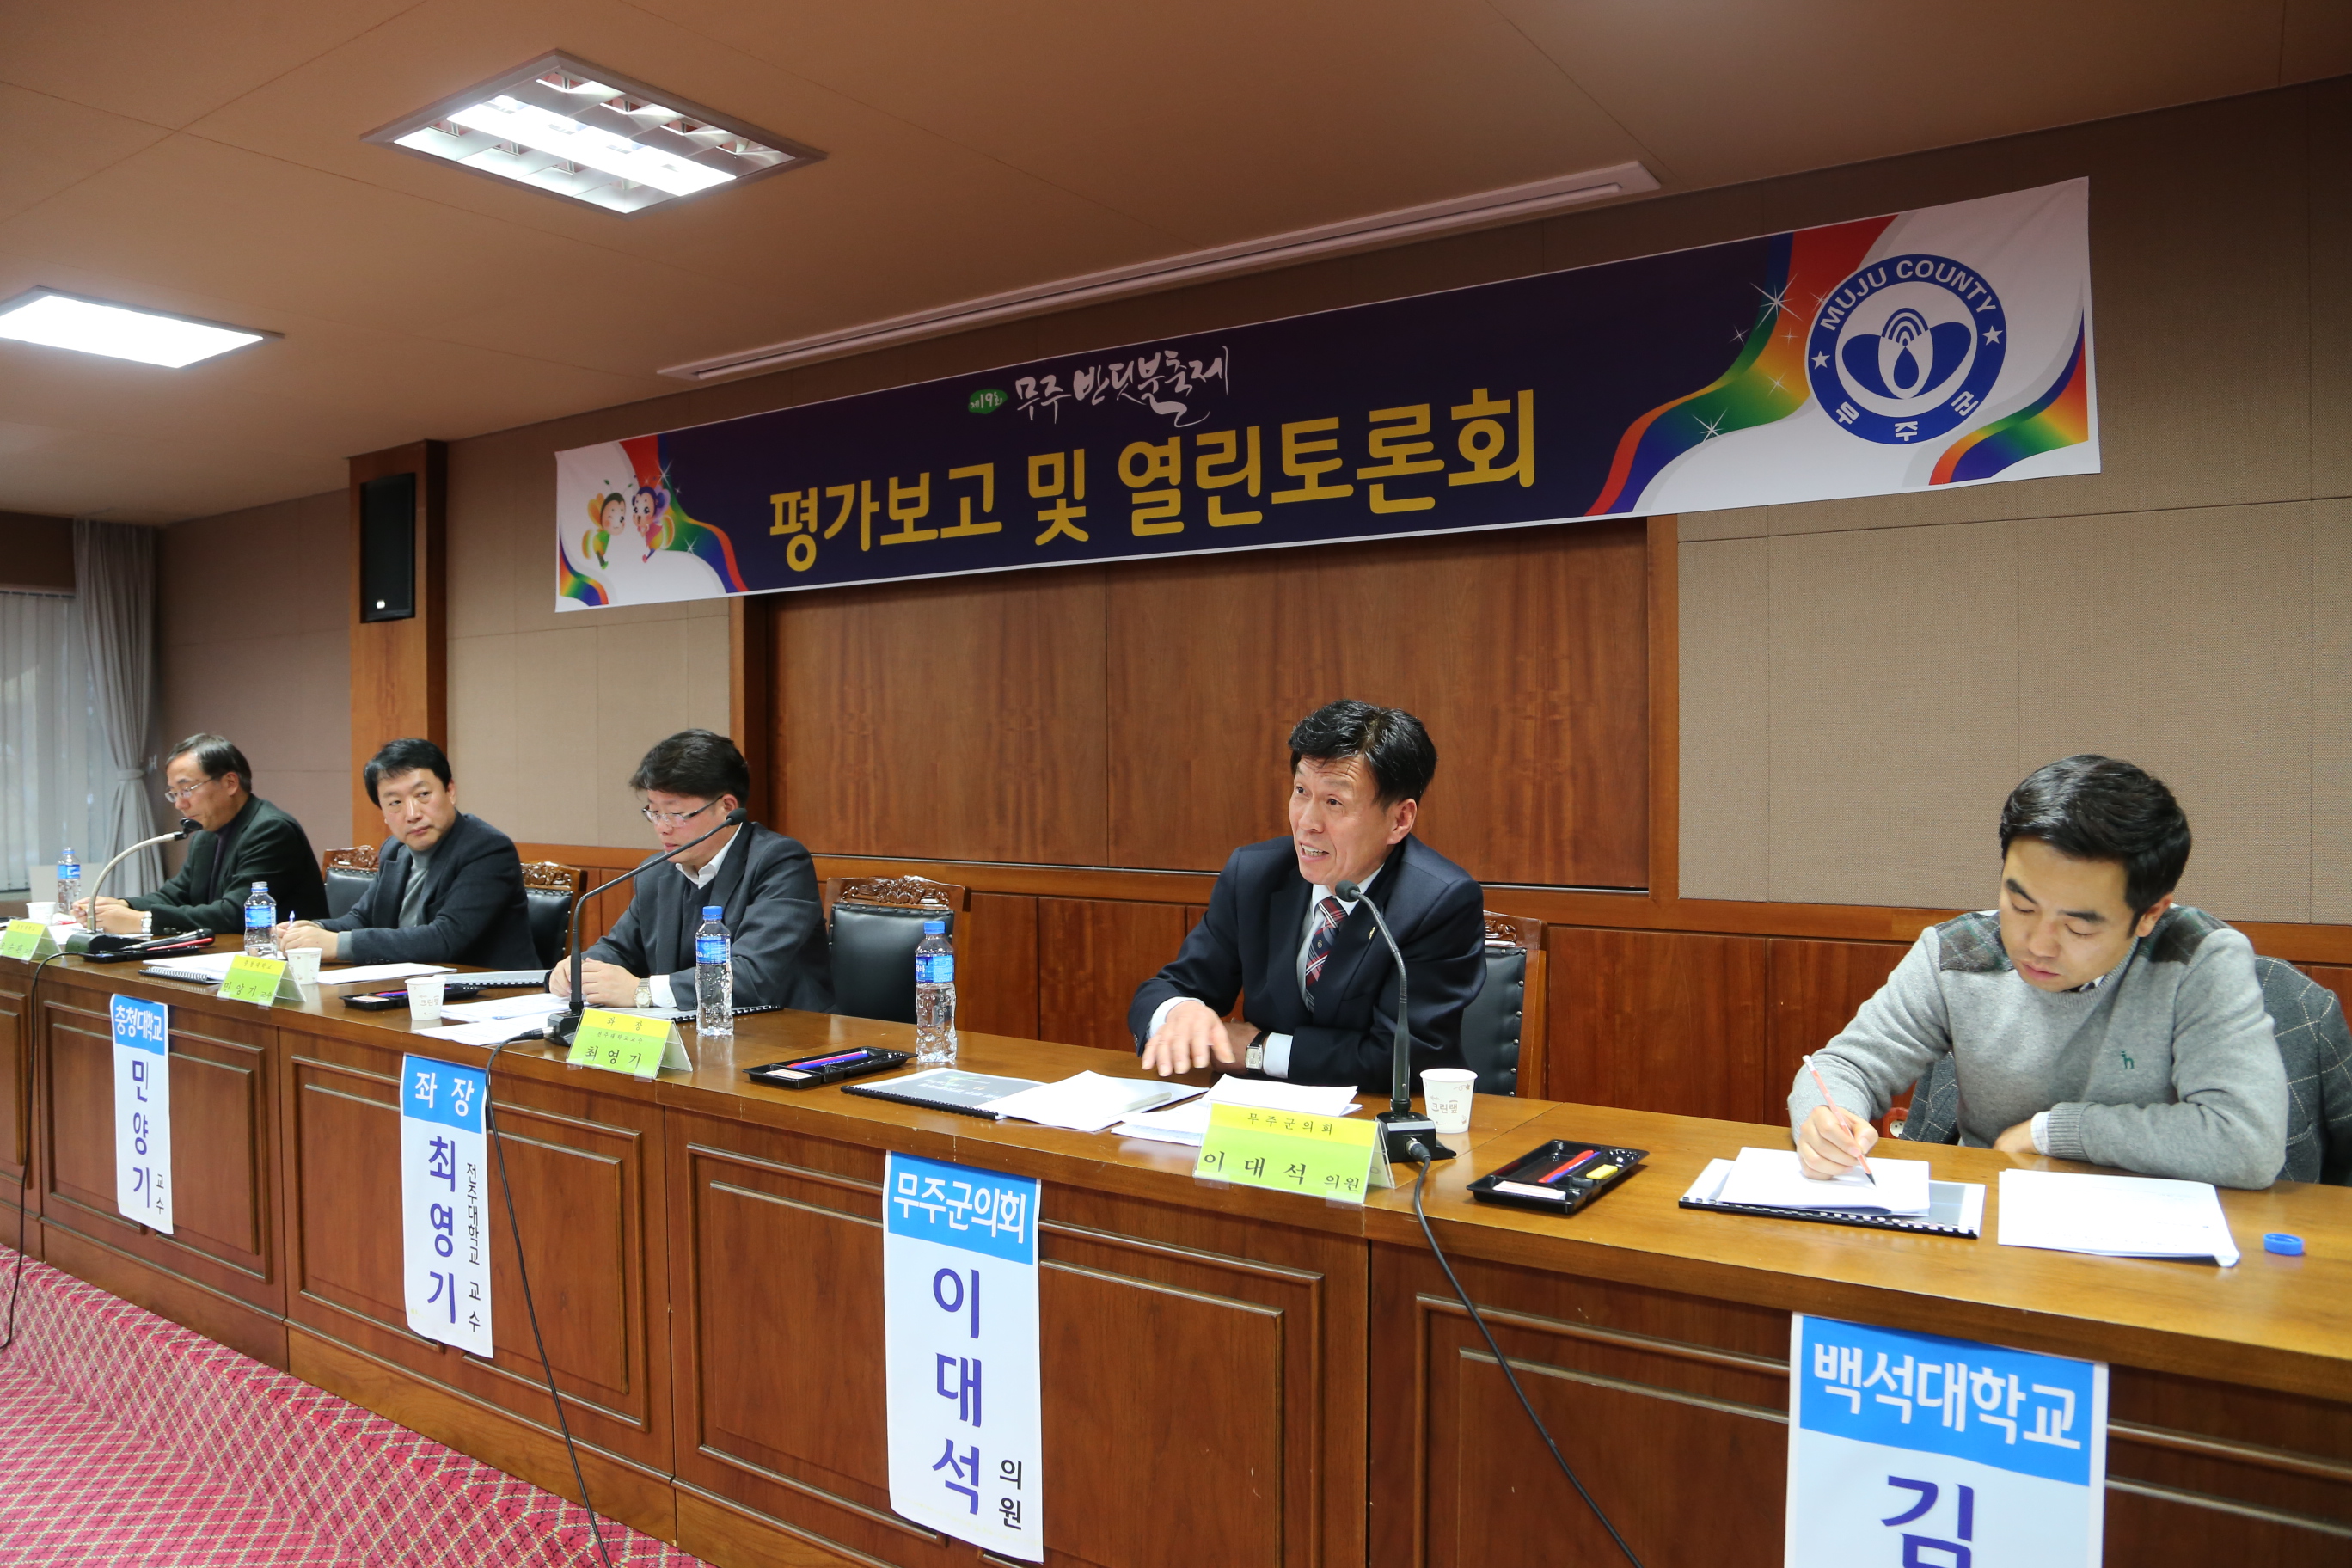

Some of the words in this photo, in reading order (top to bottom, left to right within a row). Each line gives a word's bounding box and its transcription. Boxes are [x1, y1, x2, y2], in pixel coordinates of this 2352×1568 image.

[1820, 267, 1887, 331] MUJU
[1896, 260, 1996, 313] COUNTY
[970, 391, 1003, 409] 제19회
[1015, 375, 1071, 424] 무주
[769, 462, 1002, 572] 평가보고
[1028, 449, 1089, 546] 및
[1118, 388, 1534, 537] 열린토론회
[115, 1005, 163, 1042] 충청대학교
[1247, 1112, 1333, 1136] 무주군의회
[893, 1172, 1026, 1244] 무주군의회
[1324, 1174, 1360, 1192] 의원
[1814, 1343, 2081, 1450] 백석대학교
[998, 1459, 1022, 1530] 의원
[1881, 1474, 1975, 1568] 김
